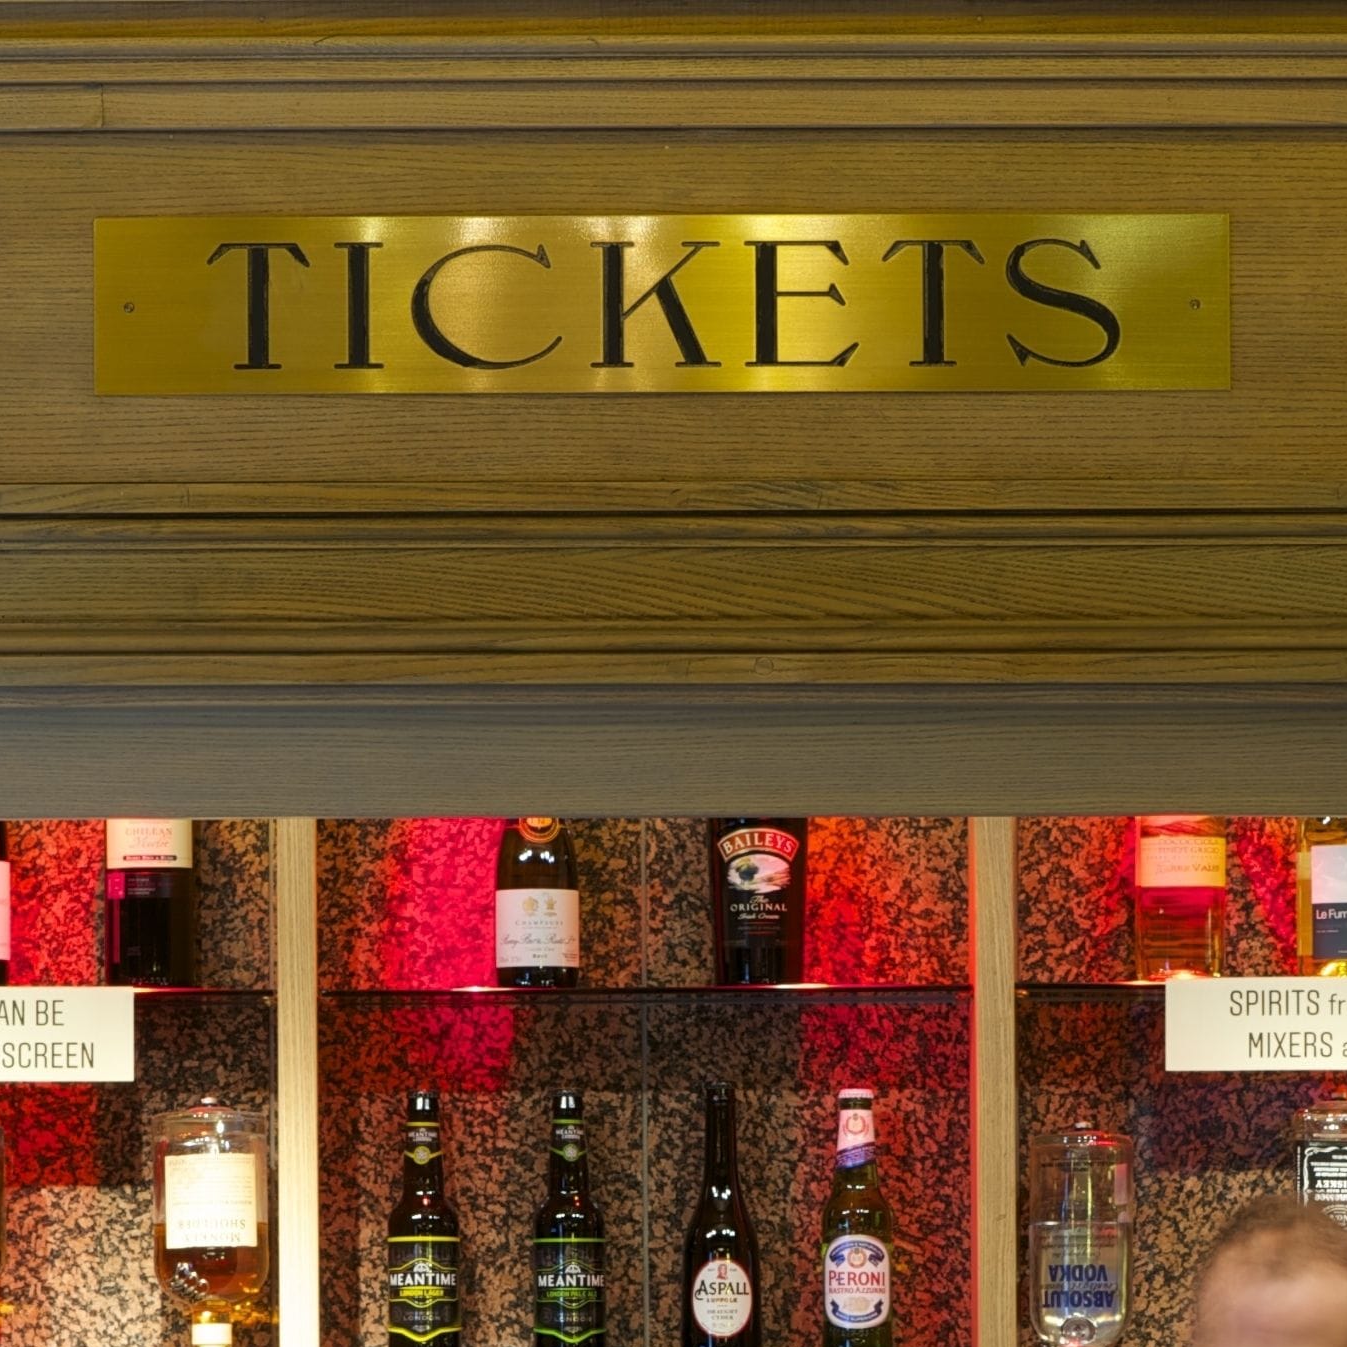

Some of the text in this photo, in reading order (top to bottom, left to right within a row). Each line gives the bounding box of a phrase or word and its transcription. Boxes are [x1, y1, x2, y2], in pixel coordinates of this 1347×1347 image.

[207, 239, 1122, 371] TICKETS
[724, 831, 796, 854] BAILEYS
[730, 903, 787, 912] ORIGINAL
[1316, 910, 1327, 919] Le
[1229, 990, 1320, 1016] SPIRITS
[36, 1001, 64, 1026] BE
[1248, 1032, 1333, 1058] MIXERS
[2, 1042, 95, 1069] SCREEN
[390, 1274, 456, 1286] MEANTIME
[538, 1275, 604, 1287] MEANTIME
[829, 1271, 885, 1286] PERONI
[1049, 1265, 1107, 1281] VODKA
[695, 1280, 749, 1300] ASPALL
[1043, 1290, 1115, 1308] ABSOLUT
